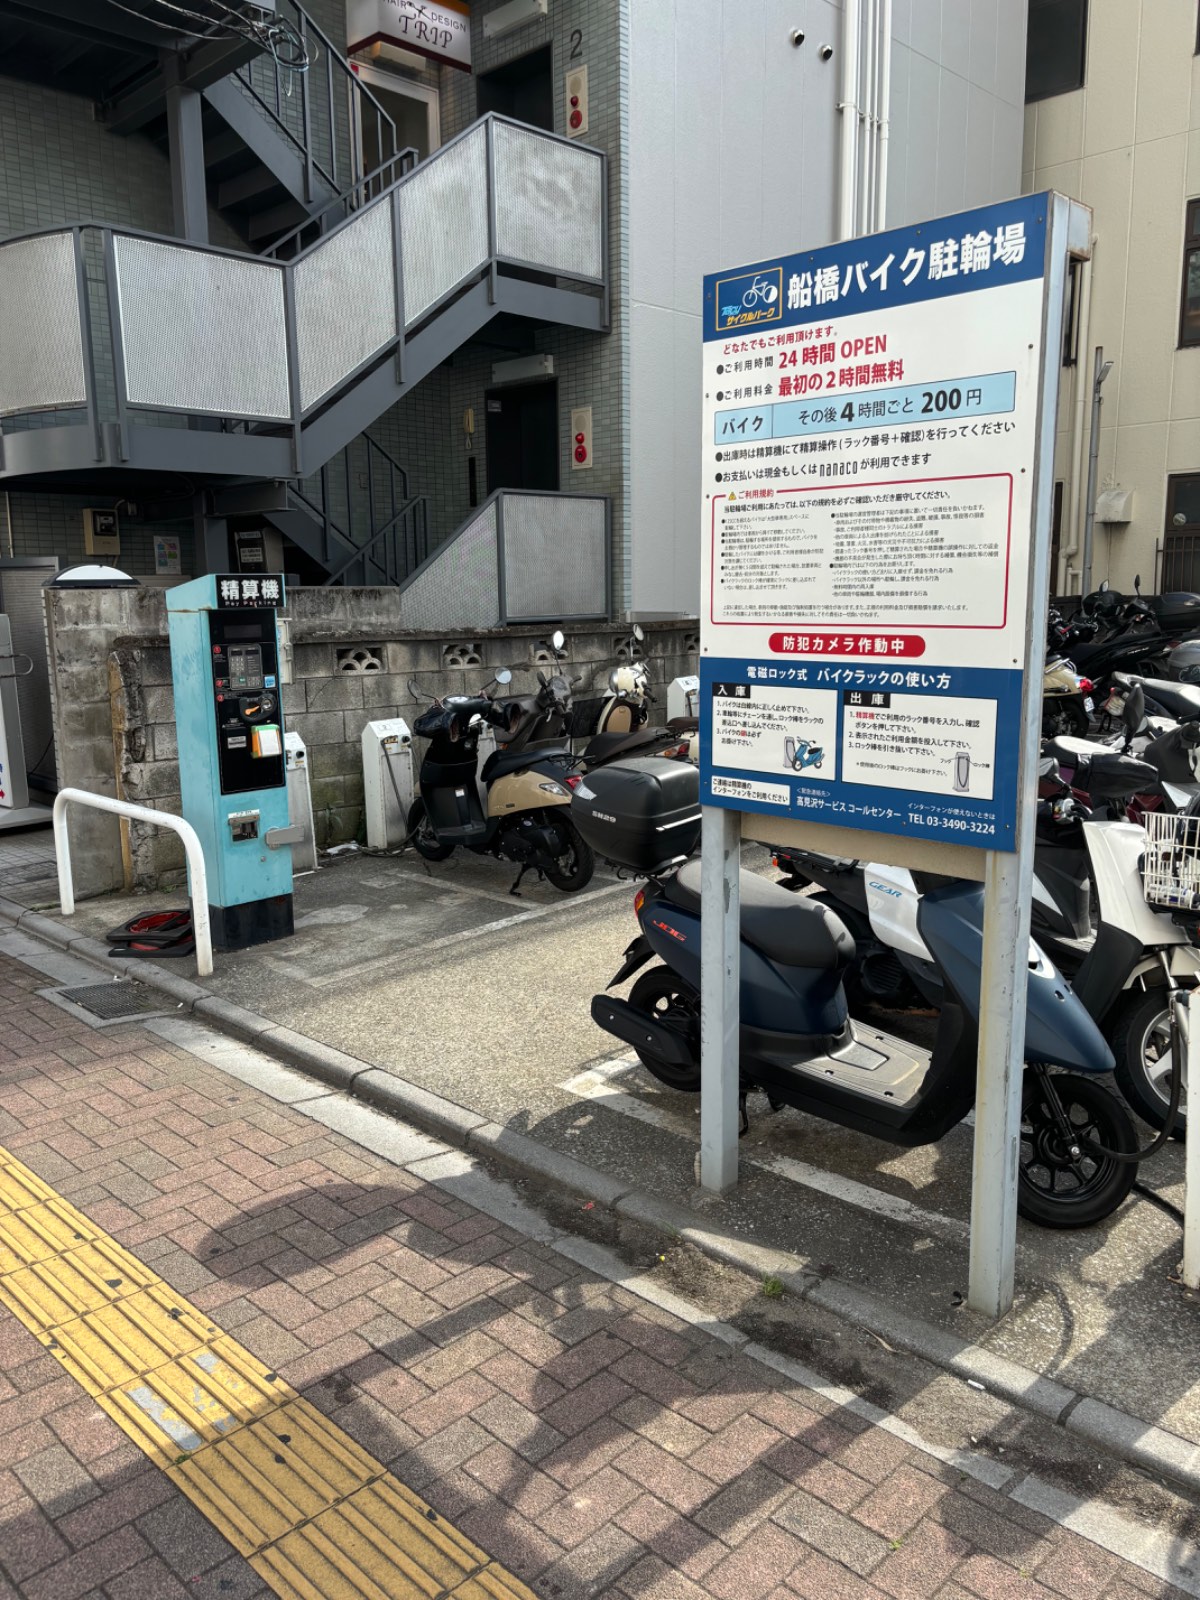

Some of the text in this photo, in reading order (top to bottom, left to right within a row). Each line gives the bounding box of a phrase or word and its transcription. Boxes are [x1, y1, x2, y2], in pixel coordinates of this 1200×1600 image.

[399, 13, 453, 49] TRIP
[431, 11, 467, 32] DESIGN
[570, 28, 583, 60] 2
[787, 222, 1027, 310] 船橋バイク駐輪場
[726, 307, 775, 326] サイクルパーク
[840, 334, 888, 361] OPEN
[778, 359, 905, 397] 最初の2時間無料
[722, 415, 764, 435] バイク
[220, 579, 280, 600] 精算機
[782, 635, 905, 654] 防犯カメラ作動中
[746, 665, 952, 690] 電磁ロック式 バイクラックの使い方
[717, 684, 746, 697] 入庫
[850, 692, 885, 706] 出庫
[591, 810, 617, 824] SH29
[848, 803, 902, 819] コールセンター
[908, 813, 996, 835] TEL 03-3490-3224
[868, 881, 903, 898] GEAR
